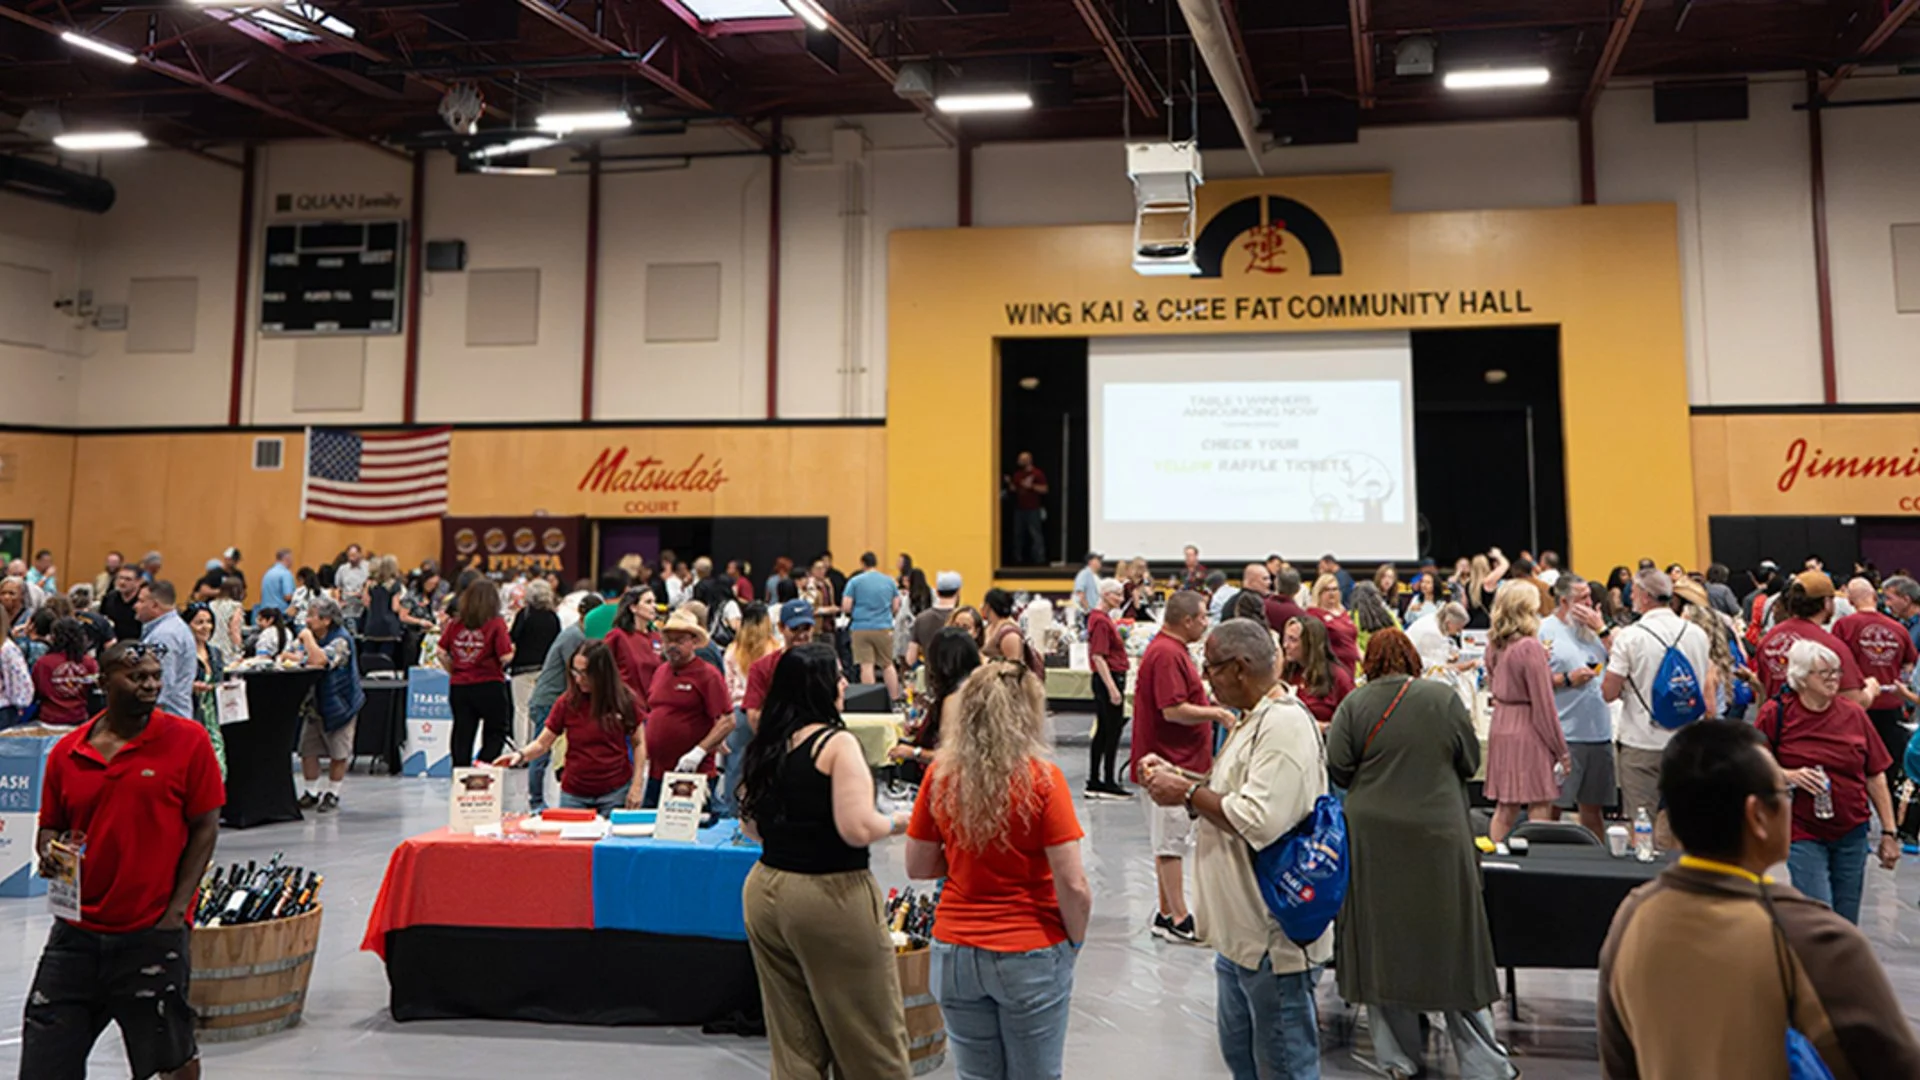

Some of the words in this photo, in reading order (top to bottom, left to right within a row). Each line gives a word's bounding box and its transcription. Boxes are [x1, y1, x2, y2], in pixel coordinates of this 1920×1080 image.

[297, 194, 355, 211] QUAN
[1005, 303, 1072, 325] WING
[1081, 301, 1123, 322] KAI
[1132, 301, 1149, 322] &
[1157, 298, 1227, 321] CHEE
[1235, 297, 1282, 319] FAT
[1287, 292, 1450, 318] COMMUNITY
[1459, 289, 1532, 314] HALL
[1201, 438, 1252, 450] CHECK
[1259, 438, 1299, 450] YOUR
[577, 446, 729, 493] Matsuda's
[1218, 459, 1277, 472] RAFFLE
[1286, 459, 1350, 472] TICKETS
[1777, 437, 1920, 493] Jimmi
[624, 500, 680, 513] COURT
[412, 692, 449, 704] TRASH
